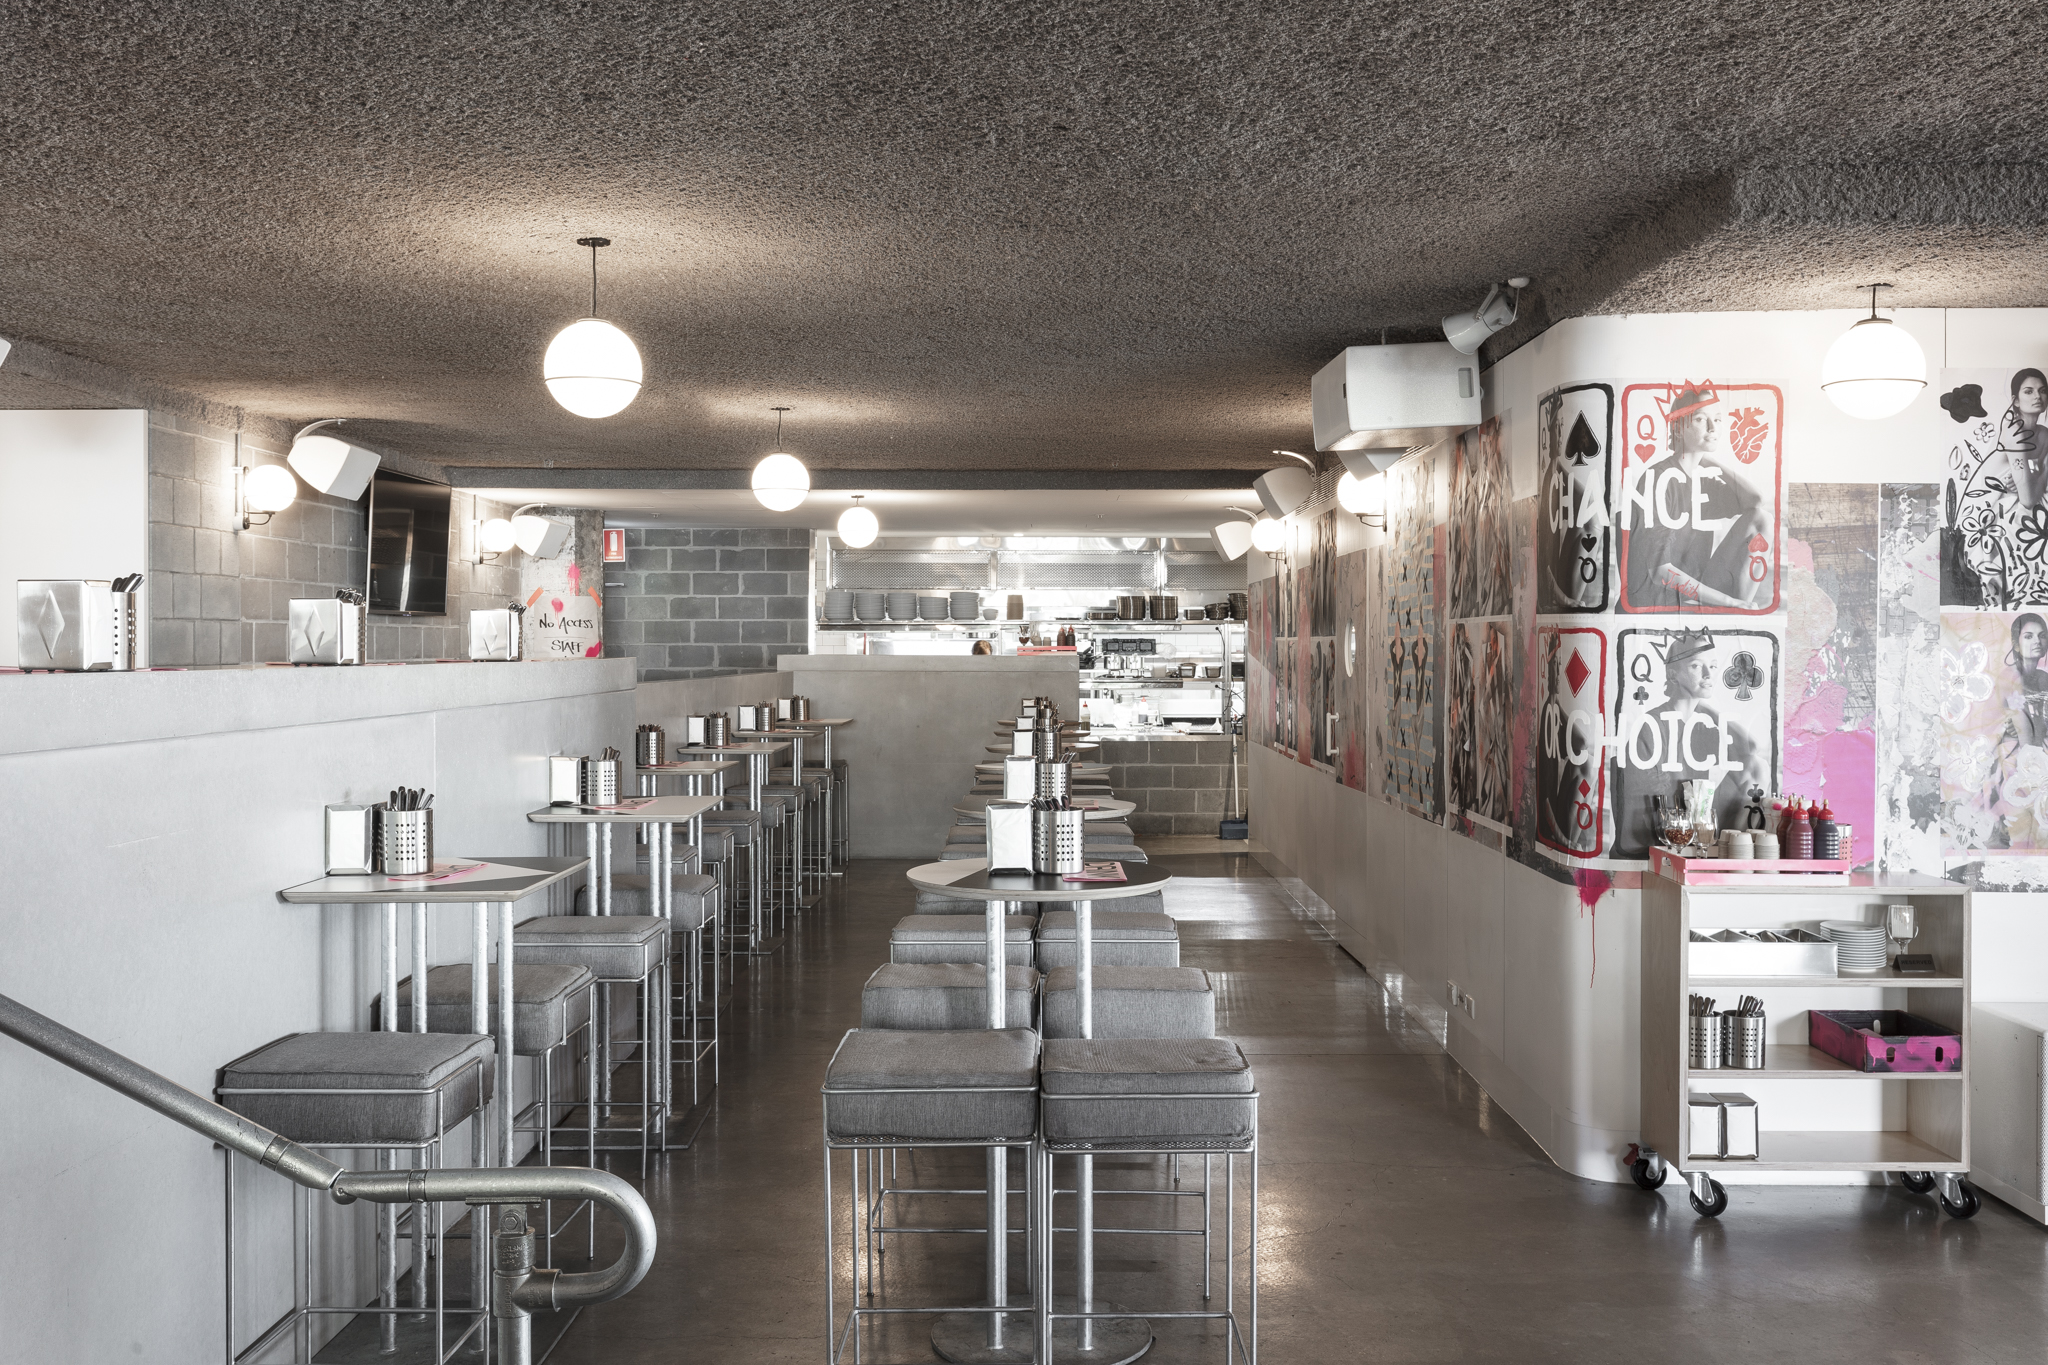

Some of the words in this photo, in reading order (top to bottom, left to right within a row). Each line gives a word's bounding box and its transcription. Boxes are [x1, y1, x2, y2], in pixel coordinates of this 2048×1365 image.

[1541, 426, 1548, 451] Q
[1637, 414, 1657, 442] Q
[1549, 465, 1726, 534] CHANCE
[1578, 556, 1597, 583] Q
[1748, 554, 1768, 582] Q
[1661, 569, 1701, 601] Judith
[1540, 653, 1547, 680] Q
[1631, 653, 1653, 683] Q
[1545, 703, 1562, 759] OR
[1566, 710, 1744, 772] CHOICE
[1574, 800, 1593, 830] Q
